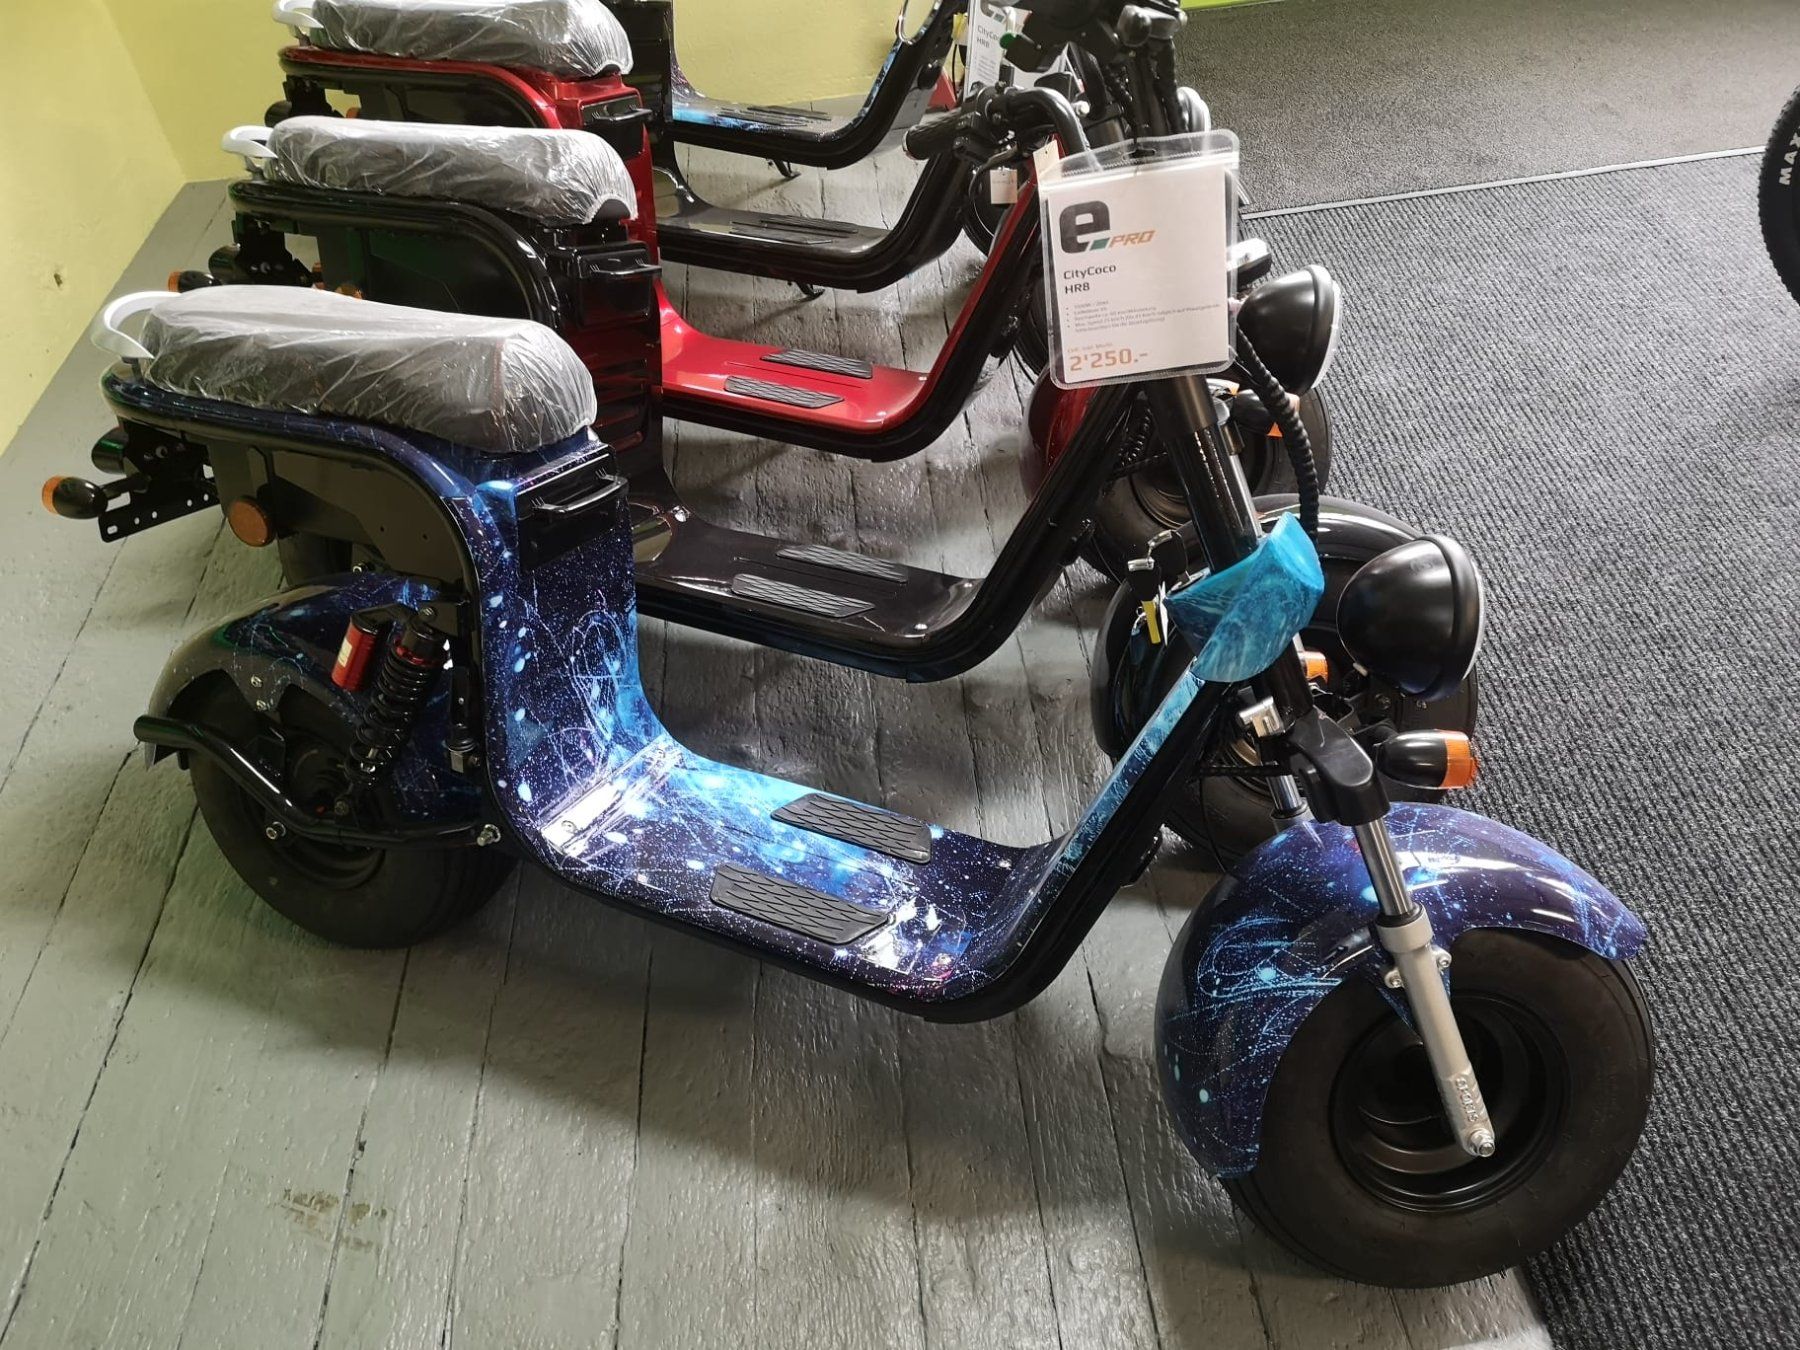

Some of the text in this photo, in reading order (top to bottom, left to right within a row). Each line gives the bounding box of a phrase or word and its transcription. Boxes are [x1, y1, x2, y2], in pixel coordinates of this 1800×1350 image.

[977, 25, 1000, 41] CityCo
[1778, 131, 1800, 186] MAX
[1059, 200, 1157, 254] e PRO
[1063, 263, 1117, 281] CityCoco
[1064, 282, 1091, 295] HR8
[1069, 347, 1149, 373] 2'250.-
